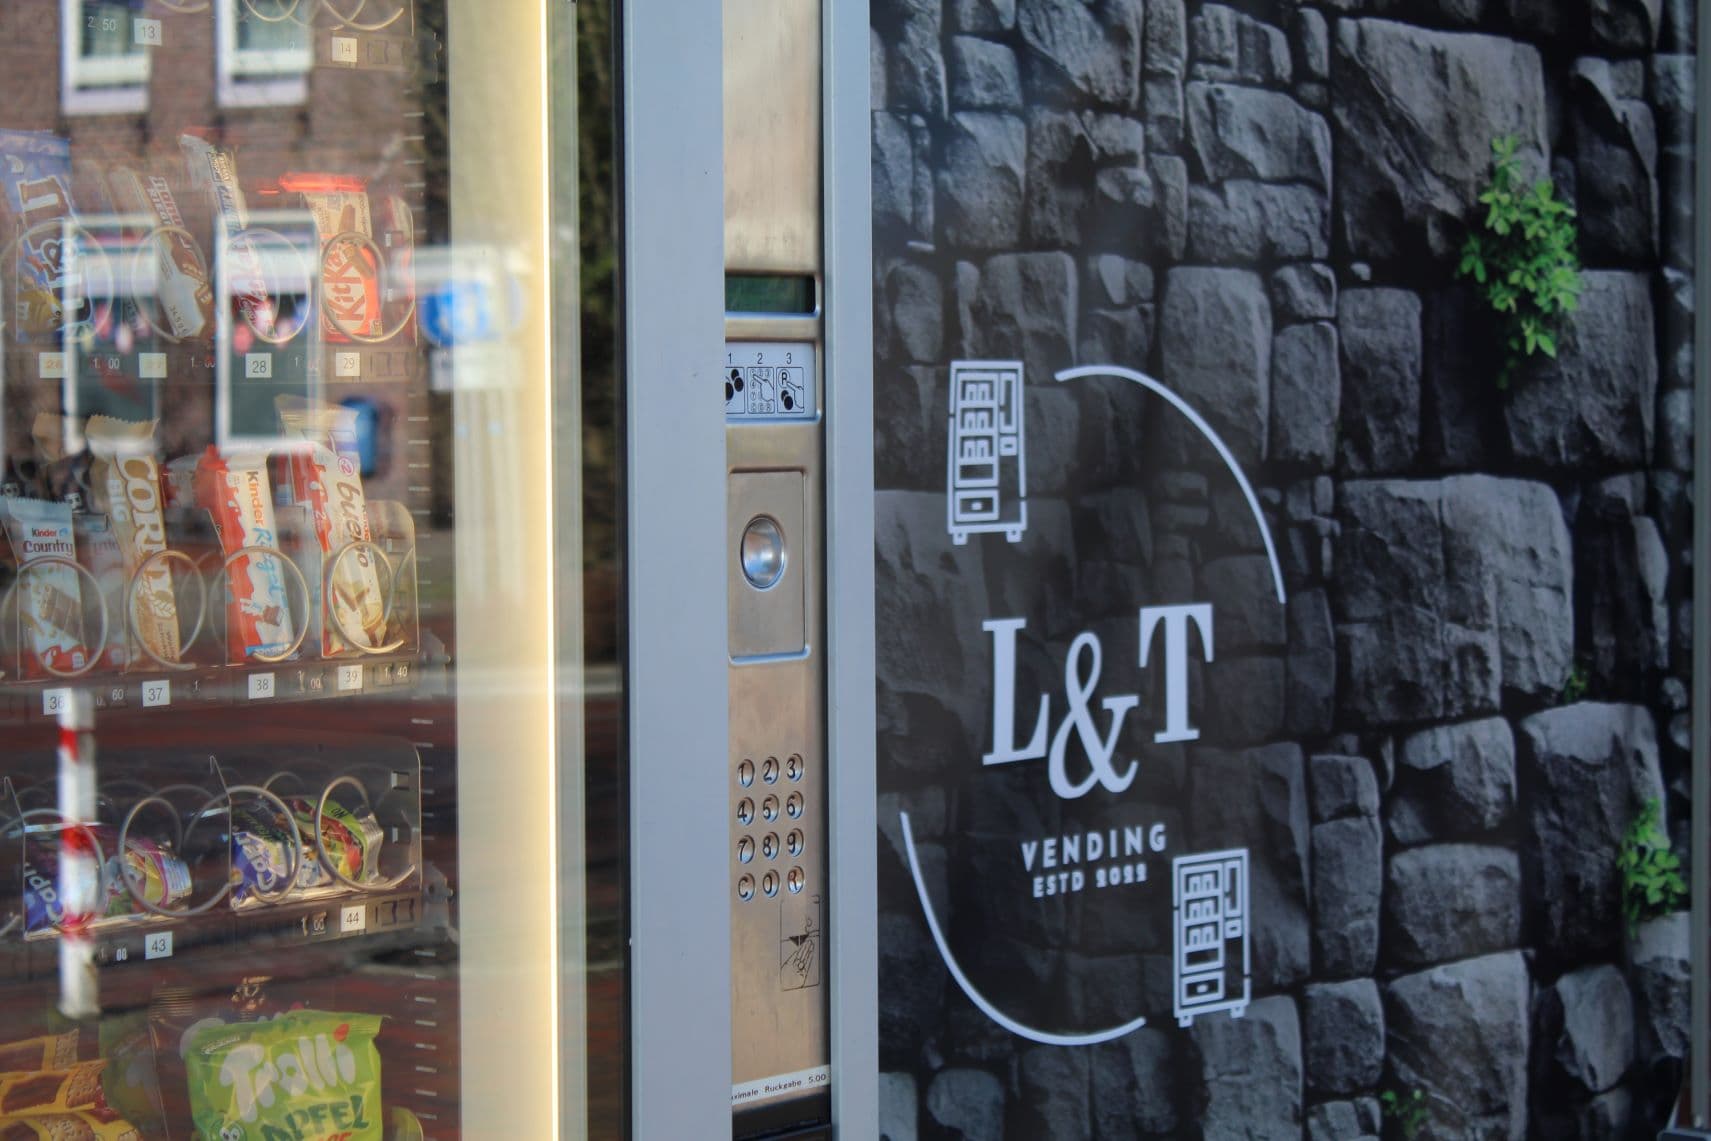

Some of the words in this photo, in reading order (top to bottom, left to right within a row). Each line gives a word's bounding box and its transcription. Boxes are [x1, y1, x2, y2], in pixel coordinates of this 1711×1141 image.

[141, 26, 156, 40] 13
[343, 357, 355, 370] 29
[756, 352, 764, 365] 2
[785, 352, 793, 365] 3
[251, 360, 267, 374] 28
[336, 481, 369, 568] bueno
[23, 539, 73, 557] Country
[345, 670, 359, 683] 39
[256, 678, 269, 692] 38
[148, 687, 163, 702] 37
[982, 603, 1214, 800] L&T
[49, 696, 65, 710] 36
[762, 759, 773, 781] 2
[786, 757, 796, 779] 3
[737, 800, 747, 822] 4
[763, 798, 772, 820] 5
[786, 795, 796, 817] 6
[737, 839, 748, 862] 7
[763, 836, 772, 858] 8
[787, 832, 796, 854] 9
[1021, 822, 1167, 872] VENDING
[1033, 870, 1084, 898] ESTD
[1096, 863, 1148, 889] 2022
[345, 911, 360, 925] 44
[151, 938, 167, 953] 43
[219, 1024, 356, 1123] Trolli
[808, 1073, 826, 1084] 5.00
[261, 1094, 369, 1141] APFEL
